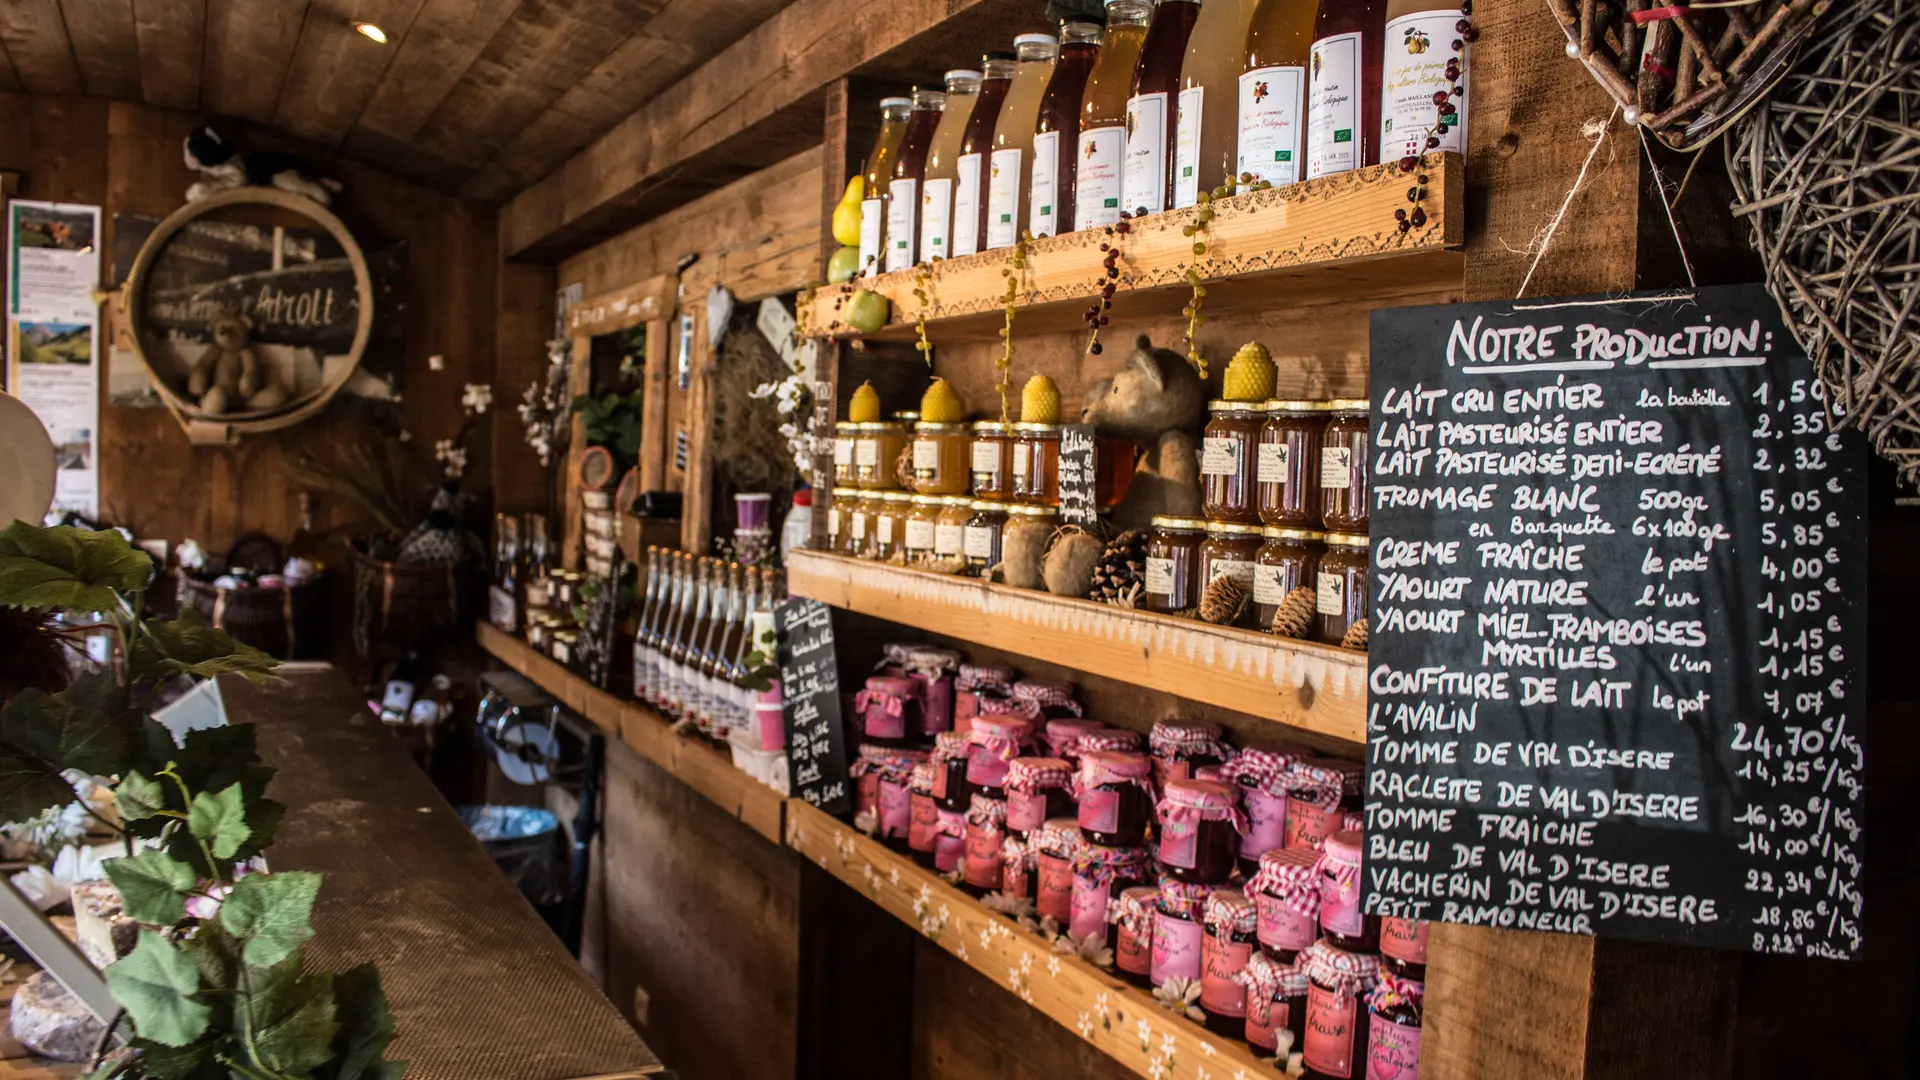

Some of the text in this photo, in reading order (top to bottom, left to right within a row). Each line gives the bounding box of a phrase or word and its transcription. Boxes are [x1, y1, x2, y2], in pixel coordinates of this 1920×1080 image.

[1446, 315, 1772, 366] NOTRE PRODUCTION:
[1381, 382, 1448, 418] LAIT
[1451, 388, 1494, 413] CRU
[1503, 373, 1604, 413] ENTIER
[1636, 388, 1663, 407] la
[1376, 420, 1434, 451] LAIT
[1438, 414, 1569, 446] PASTEURISÉ
[1573, 413, 1662, 445] ENTIER
[1375, 448, 1432, 476] LAIT
[1435, 447, 1567, 476] PASTEURISÉ
[1374, 484, 1498, 512] FROMAGE
[1511, 483, 1601, 517] BLANC
[1468, 523, 1494, 537] en
[1510, 514, 1615, 543] Barquette
[1376, 537, 1460, 569] CREME
[1476, 539, 1586, 571] FRAÎCHE
[1641, 547, 1663, 575] le
[1668, 551, 1708, 580] pot
[1378, 571, 1472, 602] YAOURT
[1484, 577, 1588, 606] NATURE
[1635, 583, 1700, 607] l'un
[1376, 606, 1465, 633] YAOURT
[1481, 637, 1617, 670] MYRTILLES
[1670, 653, 1711, 673] l'un
[1370, 664, 1509, 699] CONFITURE
[1520, 677, 1557, 706] DE
[1571, 678, 1631, 708] LAIT
[1652, 685, 1674, 709] le
[1677, 690, 1710, 719] pot
[1368, 700, 1478, 734] L'AVALIN
[1371, 735, 1459, 764] TOMME
[1473, 742, 1511, 767] DE
[1518, 740, 1560, 768] VAL
[1568, 739, 1674, 770] D'ISERE
[1369, 769, 1482, 802] RACLETTE
[1498, 781, 1533, 808] DE
[1540, 786, 1585, 818] VAL
[1588, 789, 1699, 822] D'ISERE
[1364, 802, 1456, 832] TOMME
[1478, 814, 1598, 846] FRAICHE
[1369, 834, 1430, 863] BLEU
[1451, 843, 1486, 870] DE
[1499, 849, 1541, 878] VAL
[1548, 854, 1670, 889] D'ISERE
[1364, 892, 1431, 920] PETIT
[1441, 901, 1596, 936] RAMONEUR
[1371, 866, 1491, 902] VACHERIN
[1506, 878, 1543, 905] DE
[1549, 885, 1594, 912] VAL
[1598, 892, 1718, 925] D'ISERE
